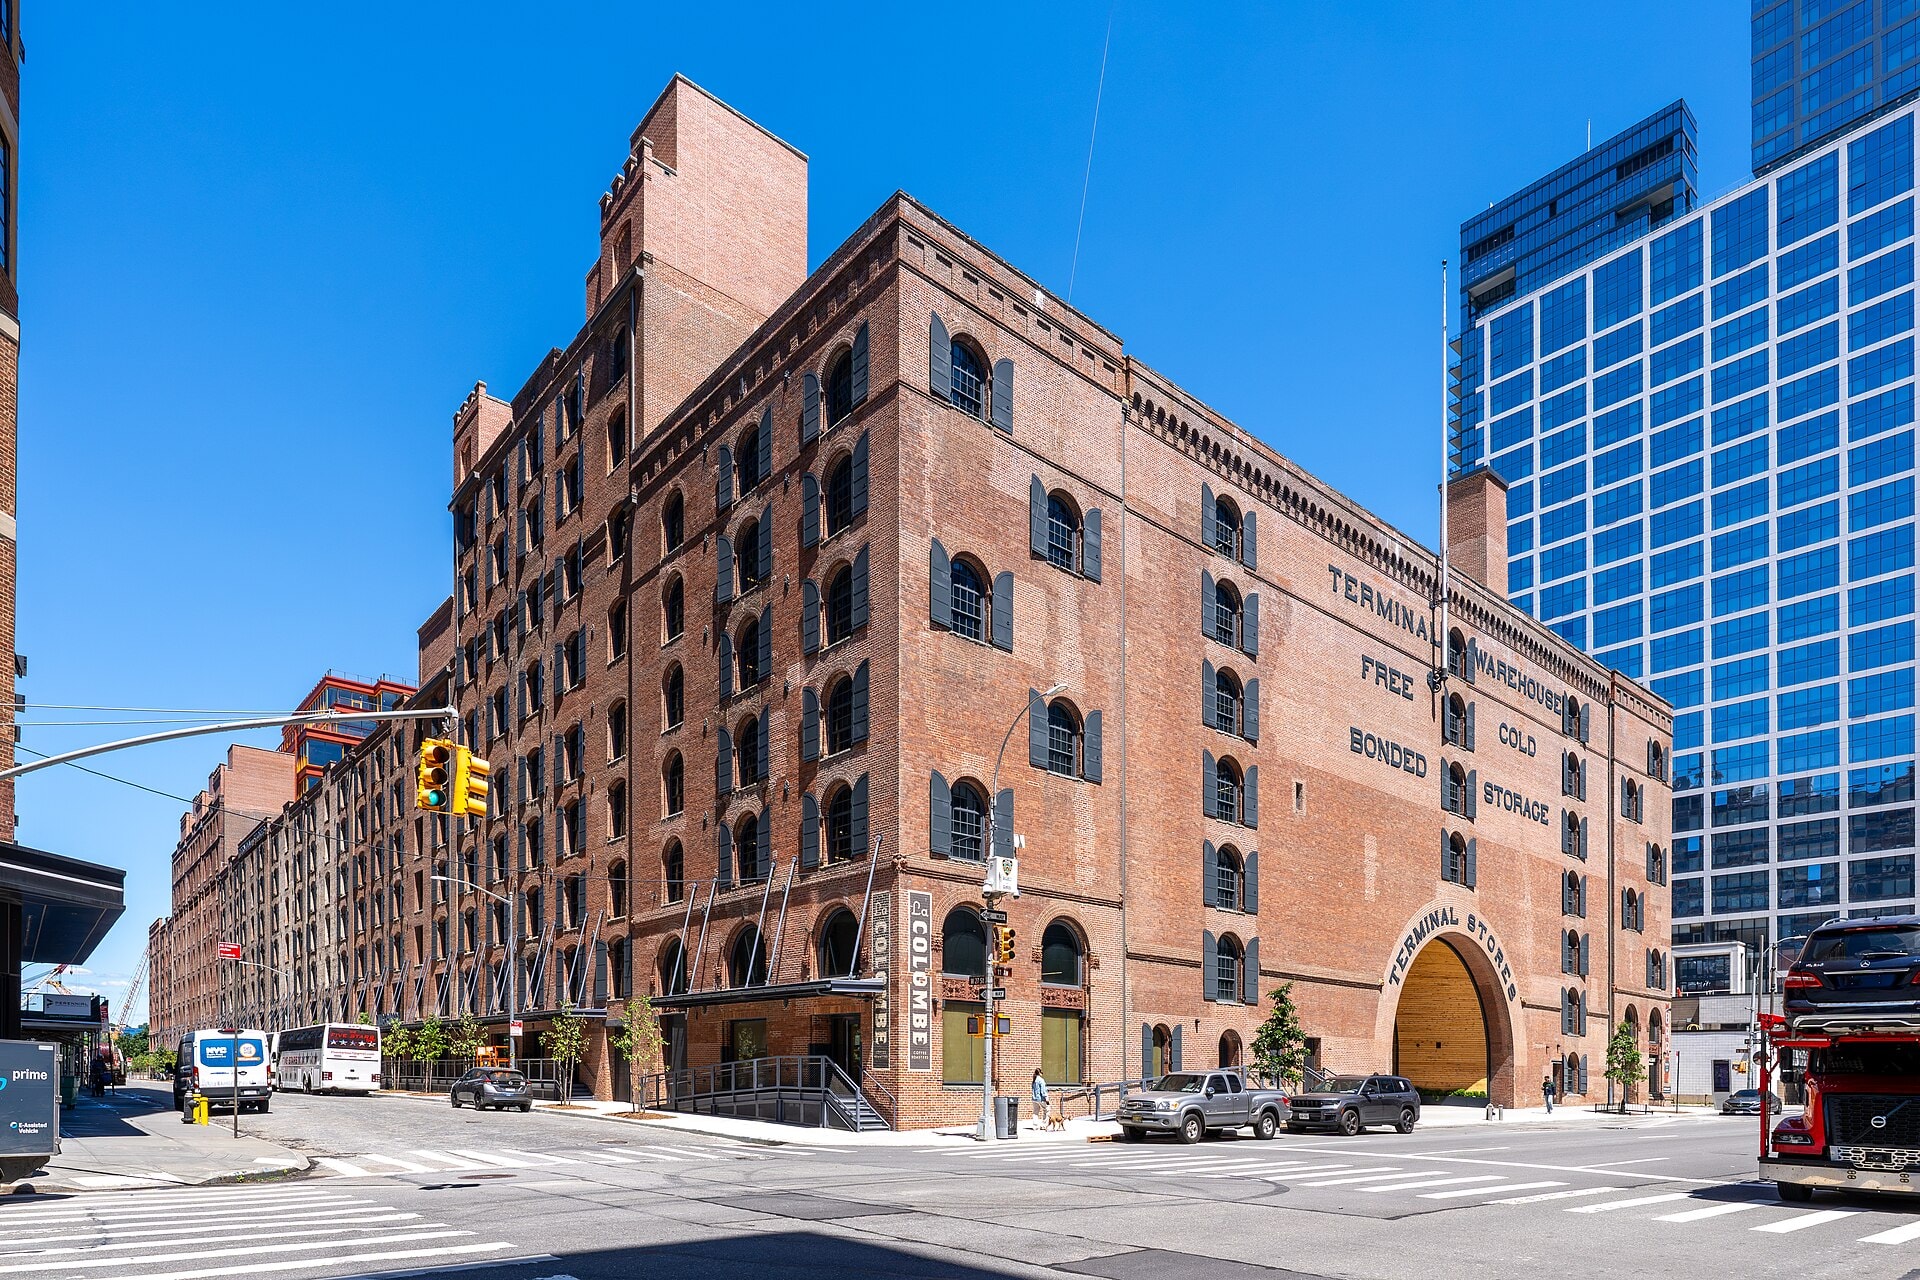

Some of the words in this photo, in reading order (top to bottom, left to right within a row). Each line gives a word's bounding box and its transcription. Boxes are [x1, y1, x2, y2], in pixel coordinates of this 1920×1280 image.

[1328, 563, 1441, 649] TERMINAL
[1361, 653, 1414, 701] FREE
[1474, 645, 1562, 716] WAREHOUSE
[1350, 726, 1427, 778] BONDED
[1499, 722, 1537, 758] COLD
[1483, 780, 1550, 826] STORAGE
[910, 901, 929, 917] La
[1388, 906, 1459, 986] TERMINAL
[1467, 913, 1517, 1002] STORES
[913, 920, 928, 1046] COLOMBE
[205, 1046, 228, 1054] NYC
[12, 1068, 48, 1081] prime
